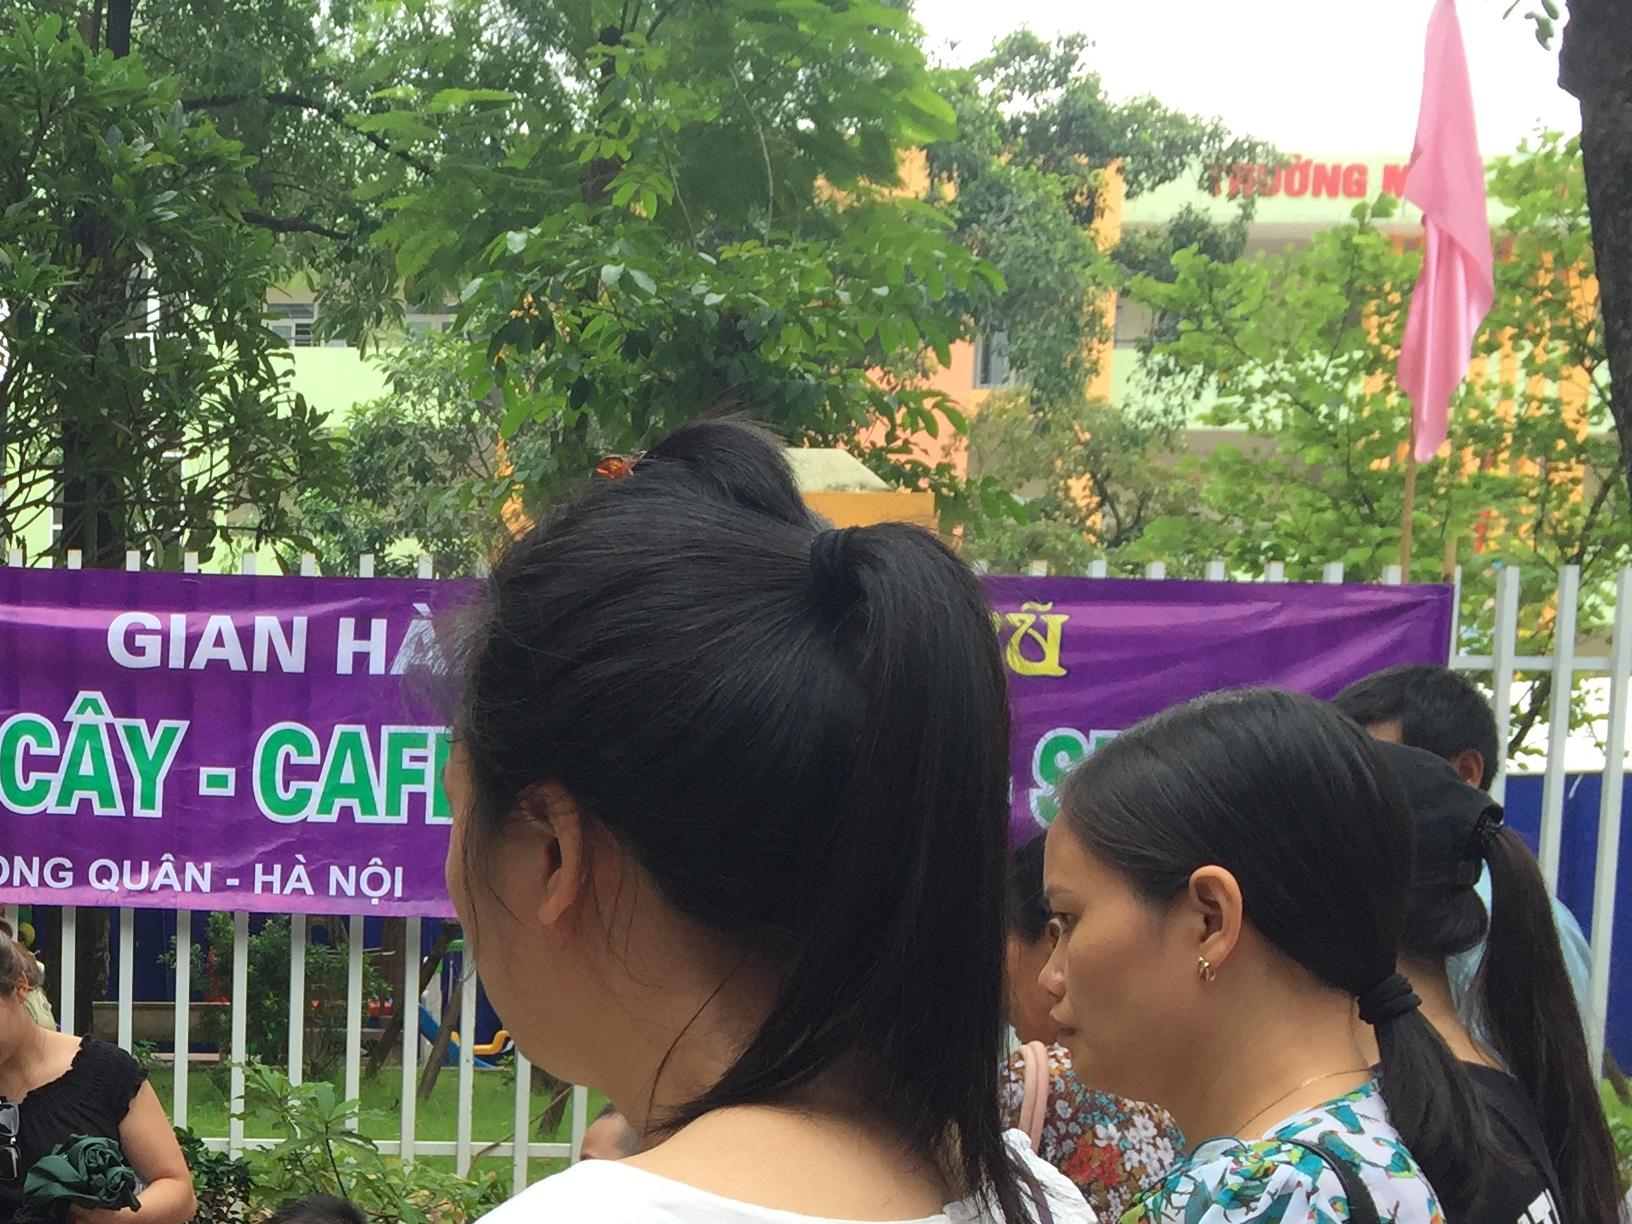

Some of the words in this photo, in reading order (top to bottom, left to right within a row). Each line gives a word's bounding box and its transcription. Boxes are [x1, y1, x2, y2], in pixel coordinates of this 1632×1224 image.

[107, 612, 308, 674] GIAN
[336, 603, 464, 676] HÀ
[88, 852, 212, 893] QUÂN
[254, 854, 312, 896] HÀ
[329, 857, 405, 904] NỘI
